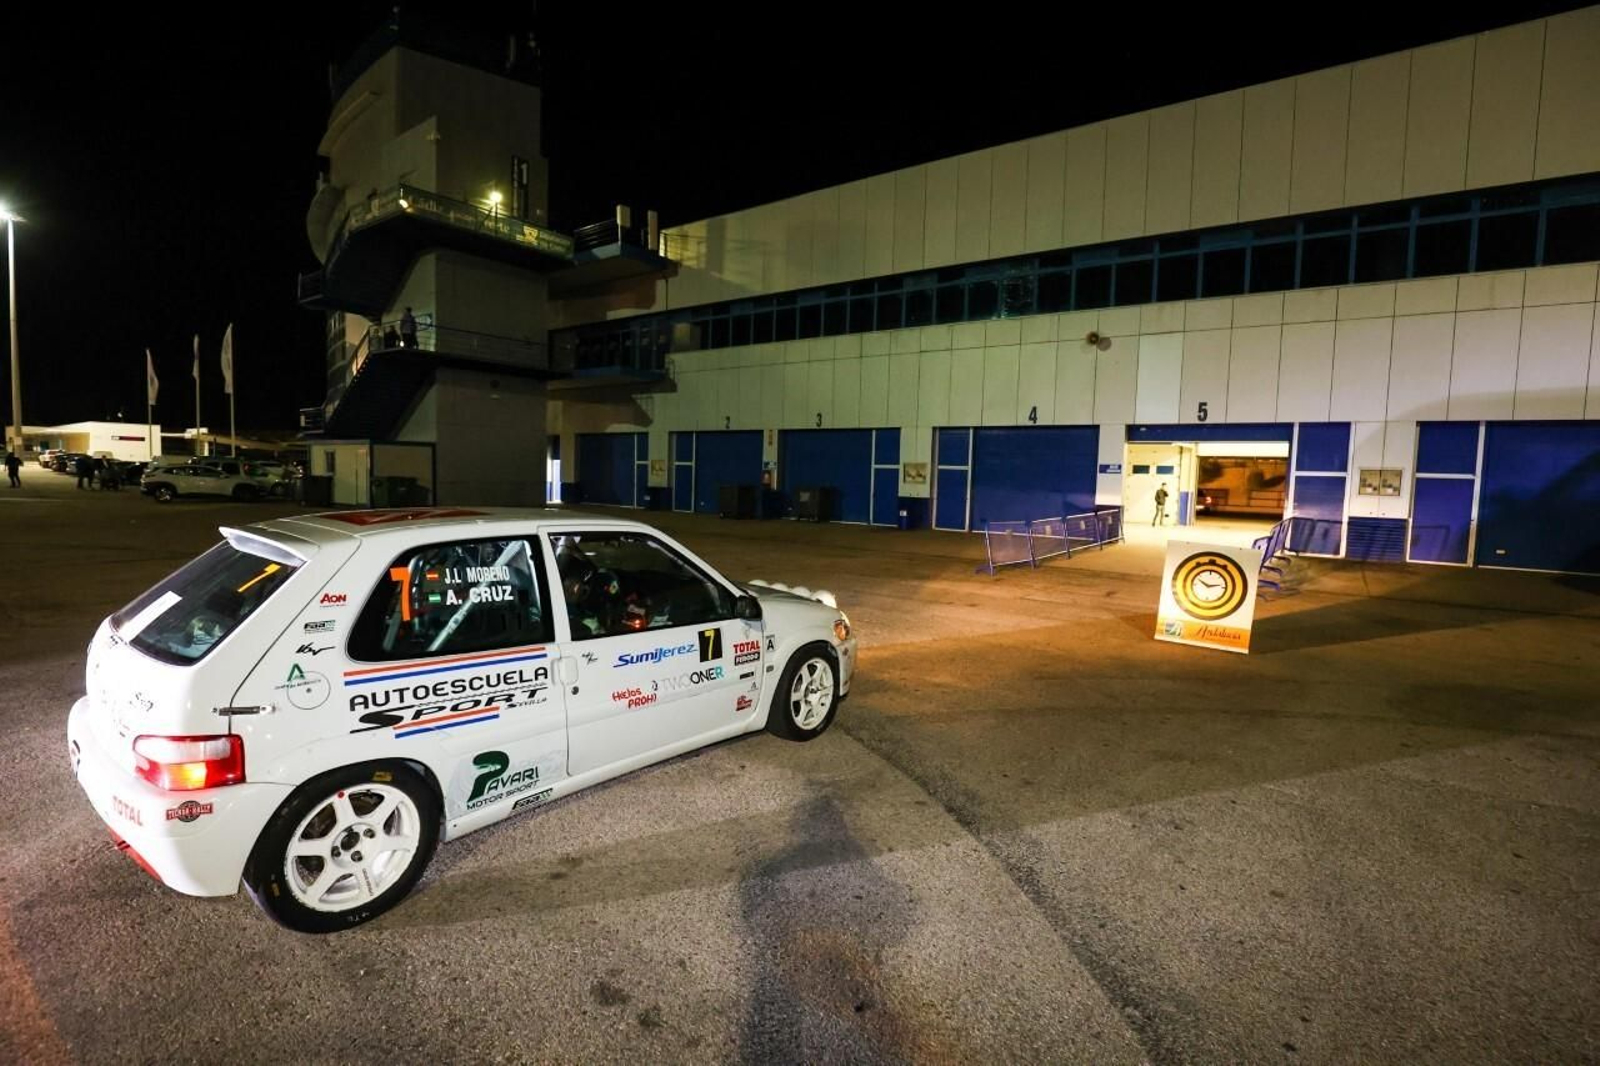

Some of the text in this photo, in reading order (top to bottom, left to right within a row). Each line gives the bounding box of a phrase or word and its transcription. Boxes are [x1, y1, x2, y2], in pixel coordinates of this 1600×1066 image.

[816, 412, 822, 428] 3
[1028, 405, 1038, 424] 4
[1196, 401, 1209, 421] 5
[725, 415, 731, 430] 2
[466, 565, 511, 583] MORENO
[389, 566, 412, 622] 7
[445, 584, 514, 606] A. CRUZ
[704, 629, 715, 661] 7
[733, 640, 760, 654] TOTAL
[349, 666, 548, 712] AUTOESCUELA
[349, 686, 548, 734] SPORT
[466, 780, 540, 811] MOTOR SPORT
[112, 795, 144, 827] TOTAL
